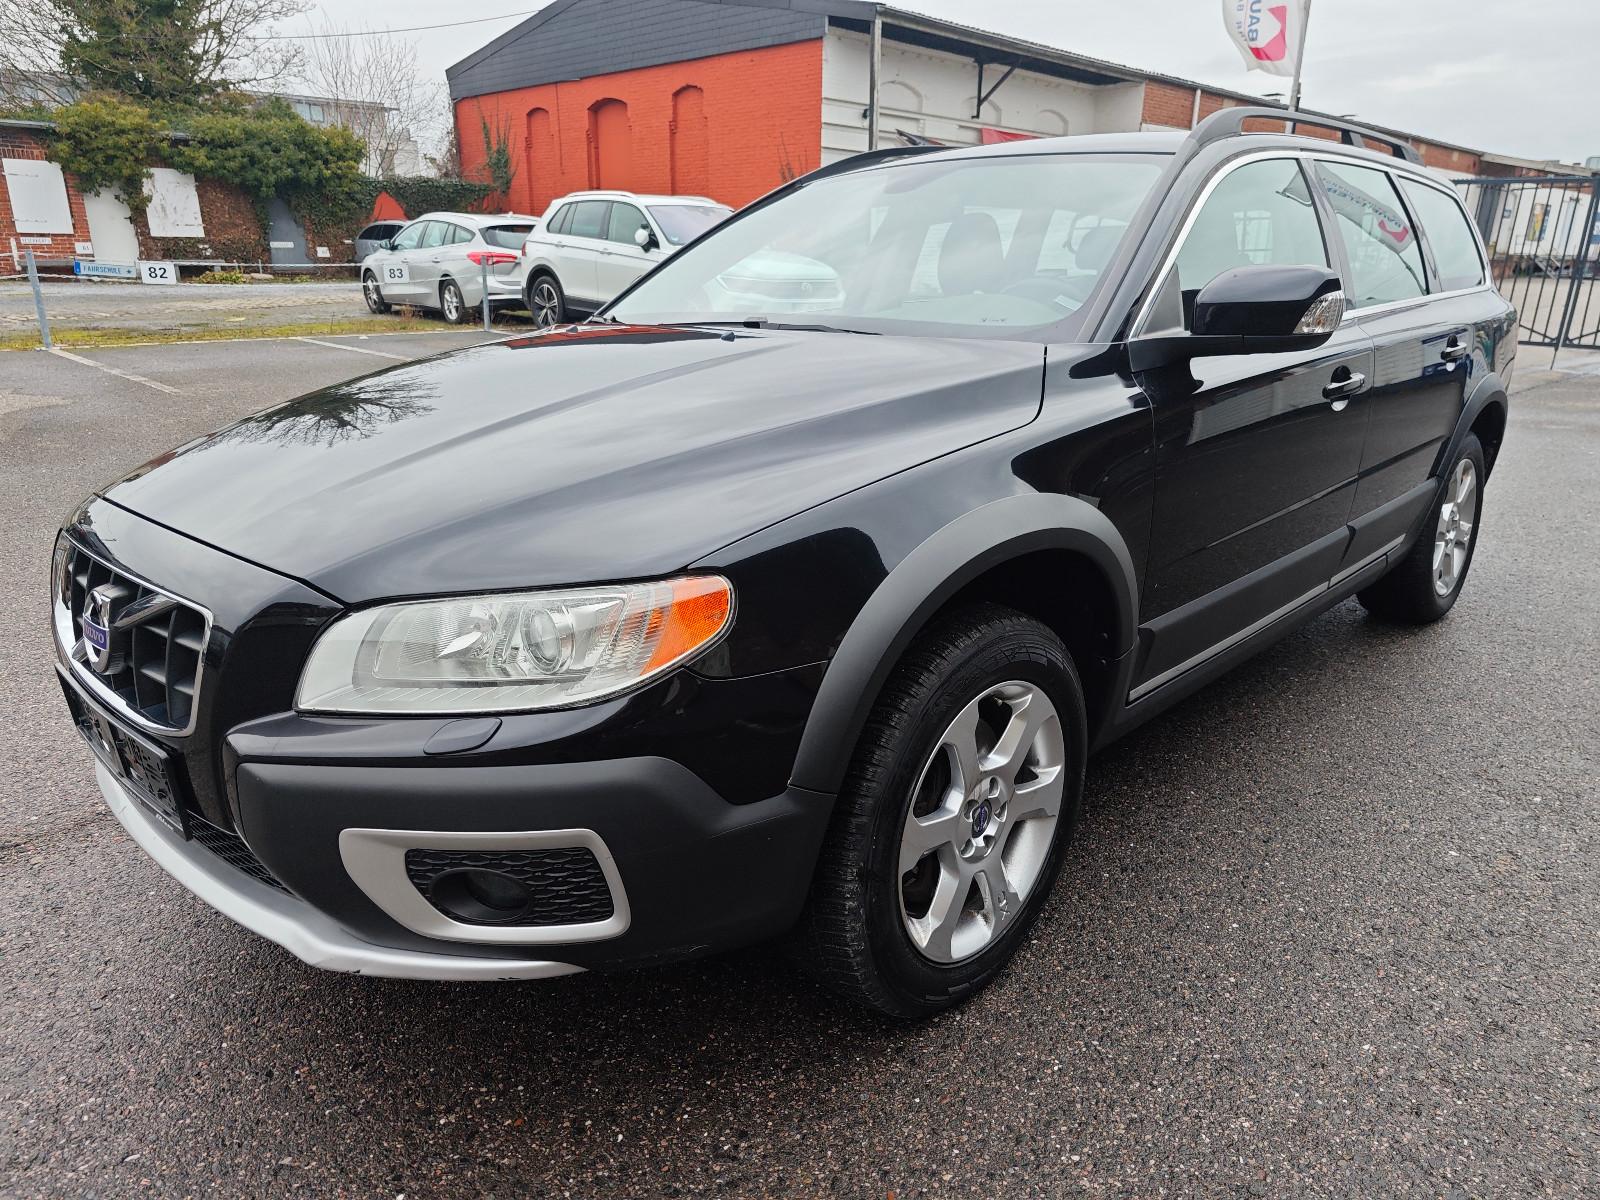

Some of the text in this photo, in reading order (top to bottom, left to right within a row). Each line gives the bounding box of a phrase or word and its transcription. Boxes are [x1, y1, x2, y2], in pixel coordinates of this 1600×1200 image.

[83, 265, 122, 274] FAHRSCHULE
[148, 266, 168, 279] 82
[388, 268, 404, 279] 83
